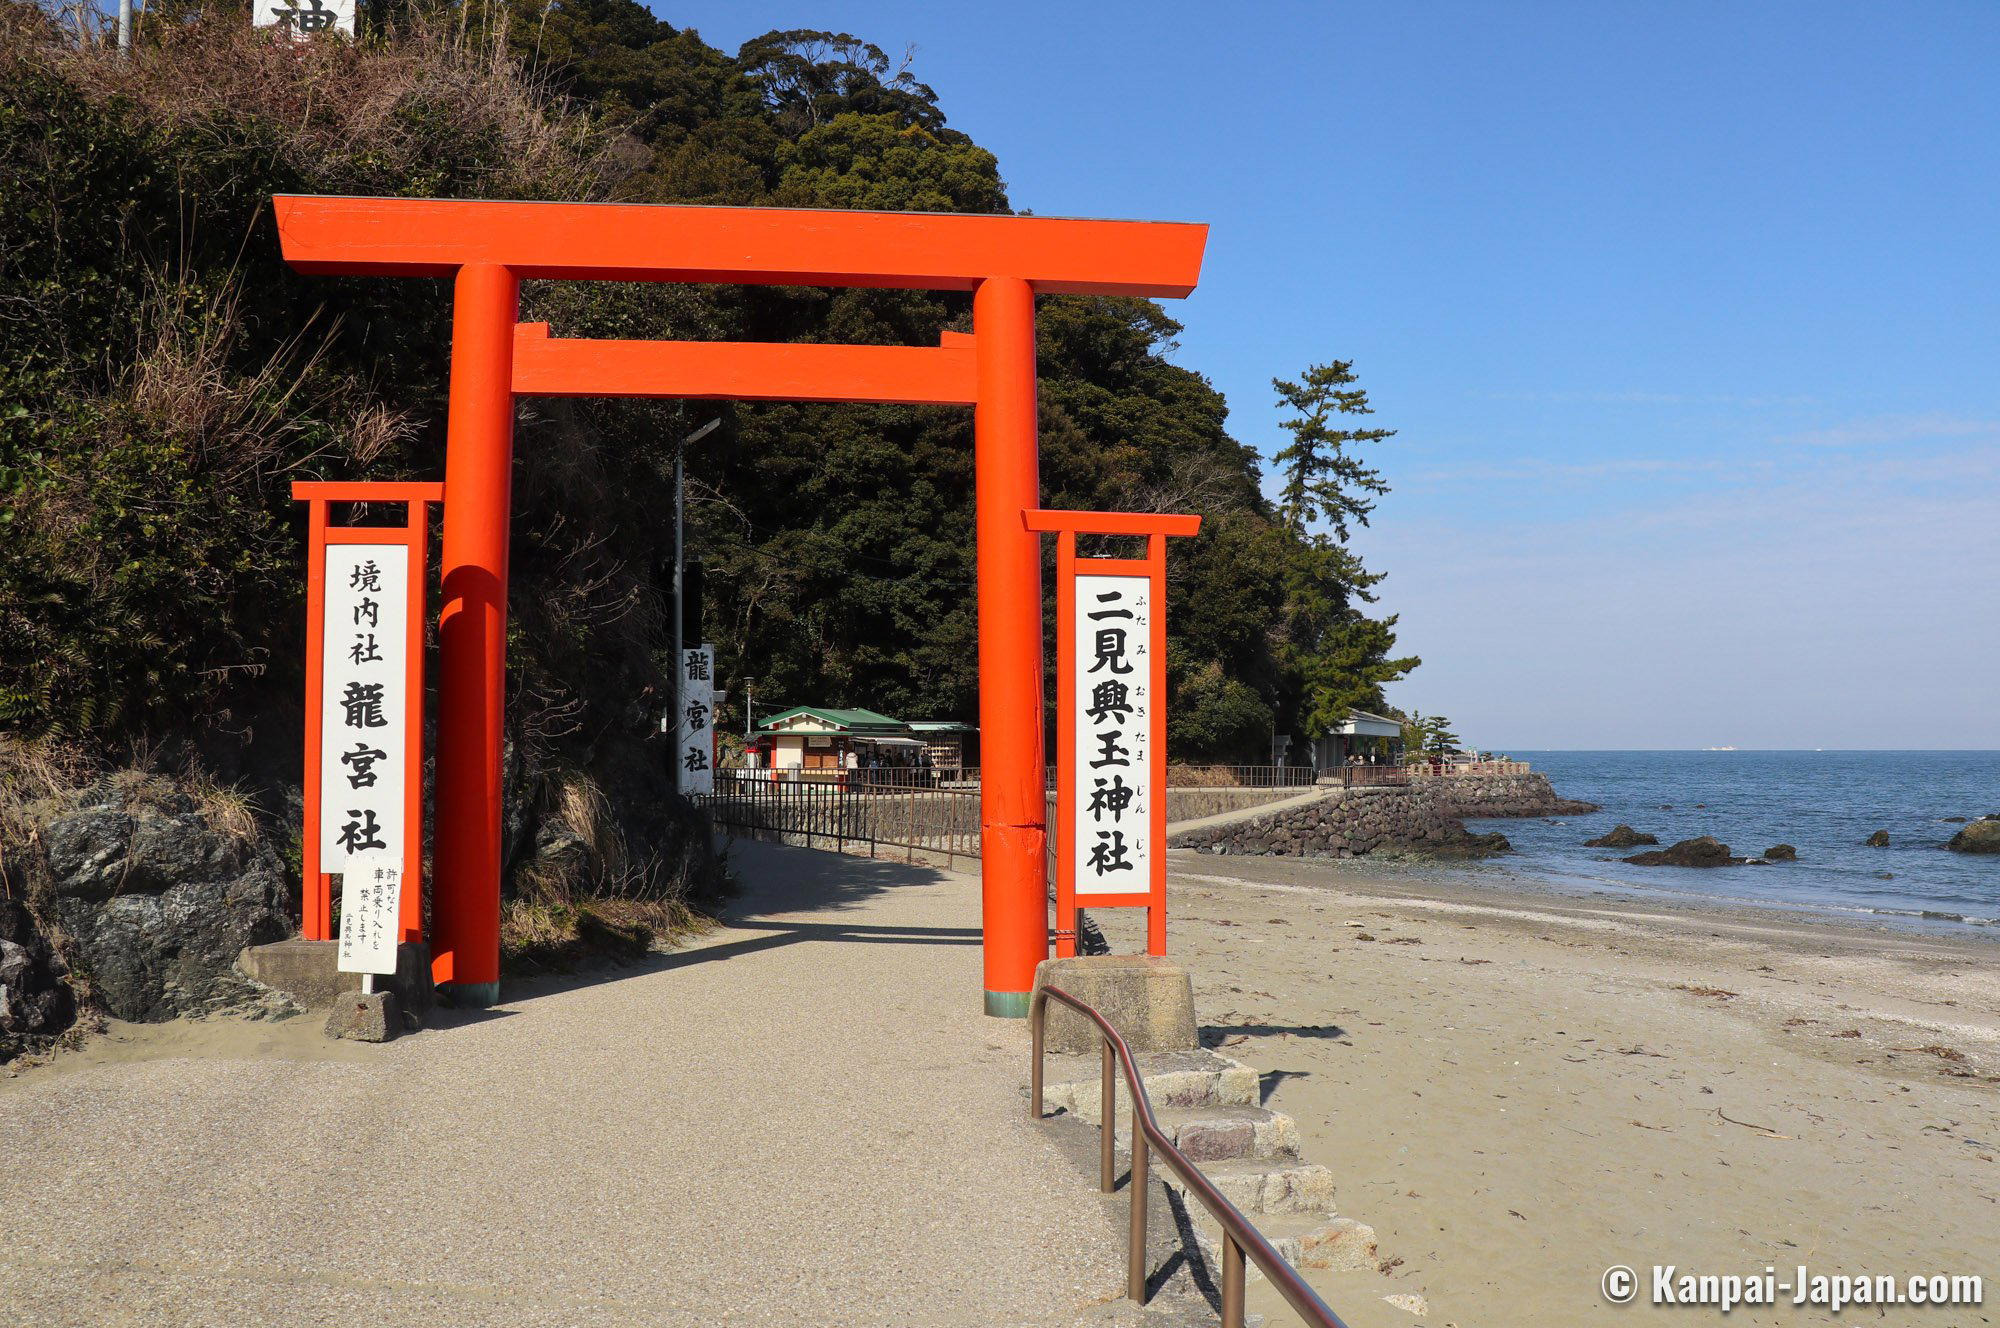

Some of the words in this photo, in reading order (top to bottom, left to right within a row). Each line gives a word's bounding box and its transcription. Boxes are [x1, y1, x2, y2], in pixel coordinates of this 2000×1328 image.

[349, 560, 383, 665] 境内社
[337, 682, 388, 854] 龍宮社
[685, 651, 709, 772] 龍宮社
[1086, 591, 1134, 876] 二見興玉神社
